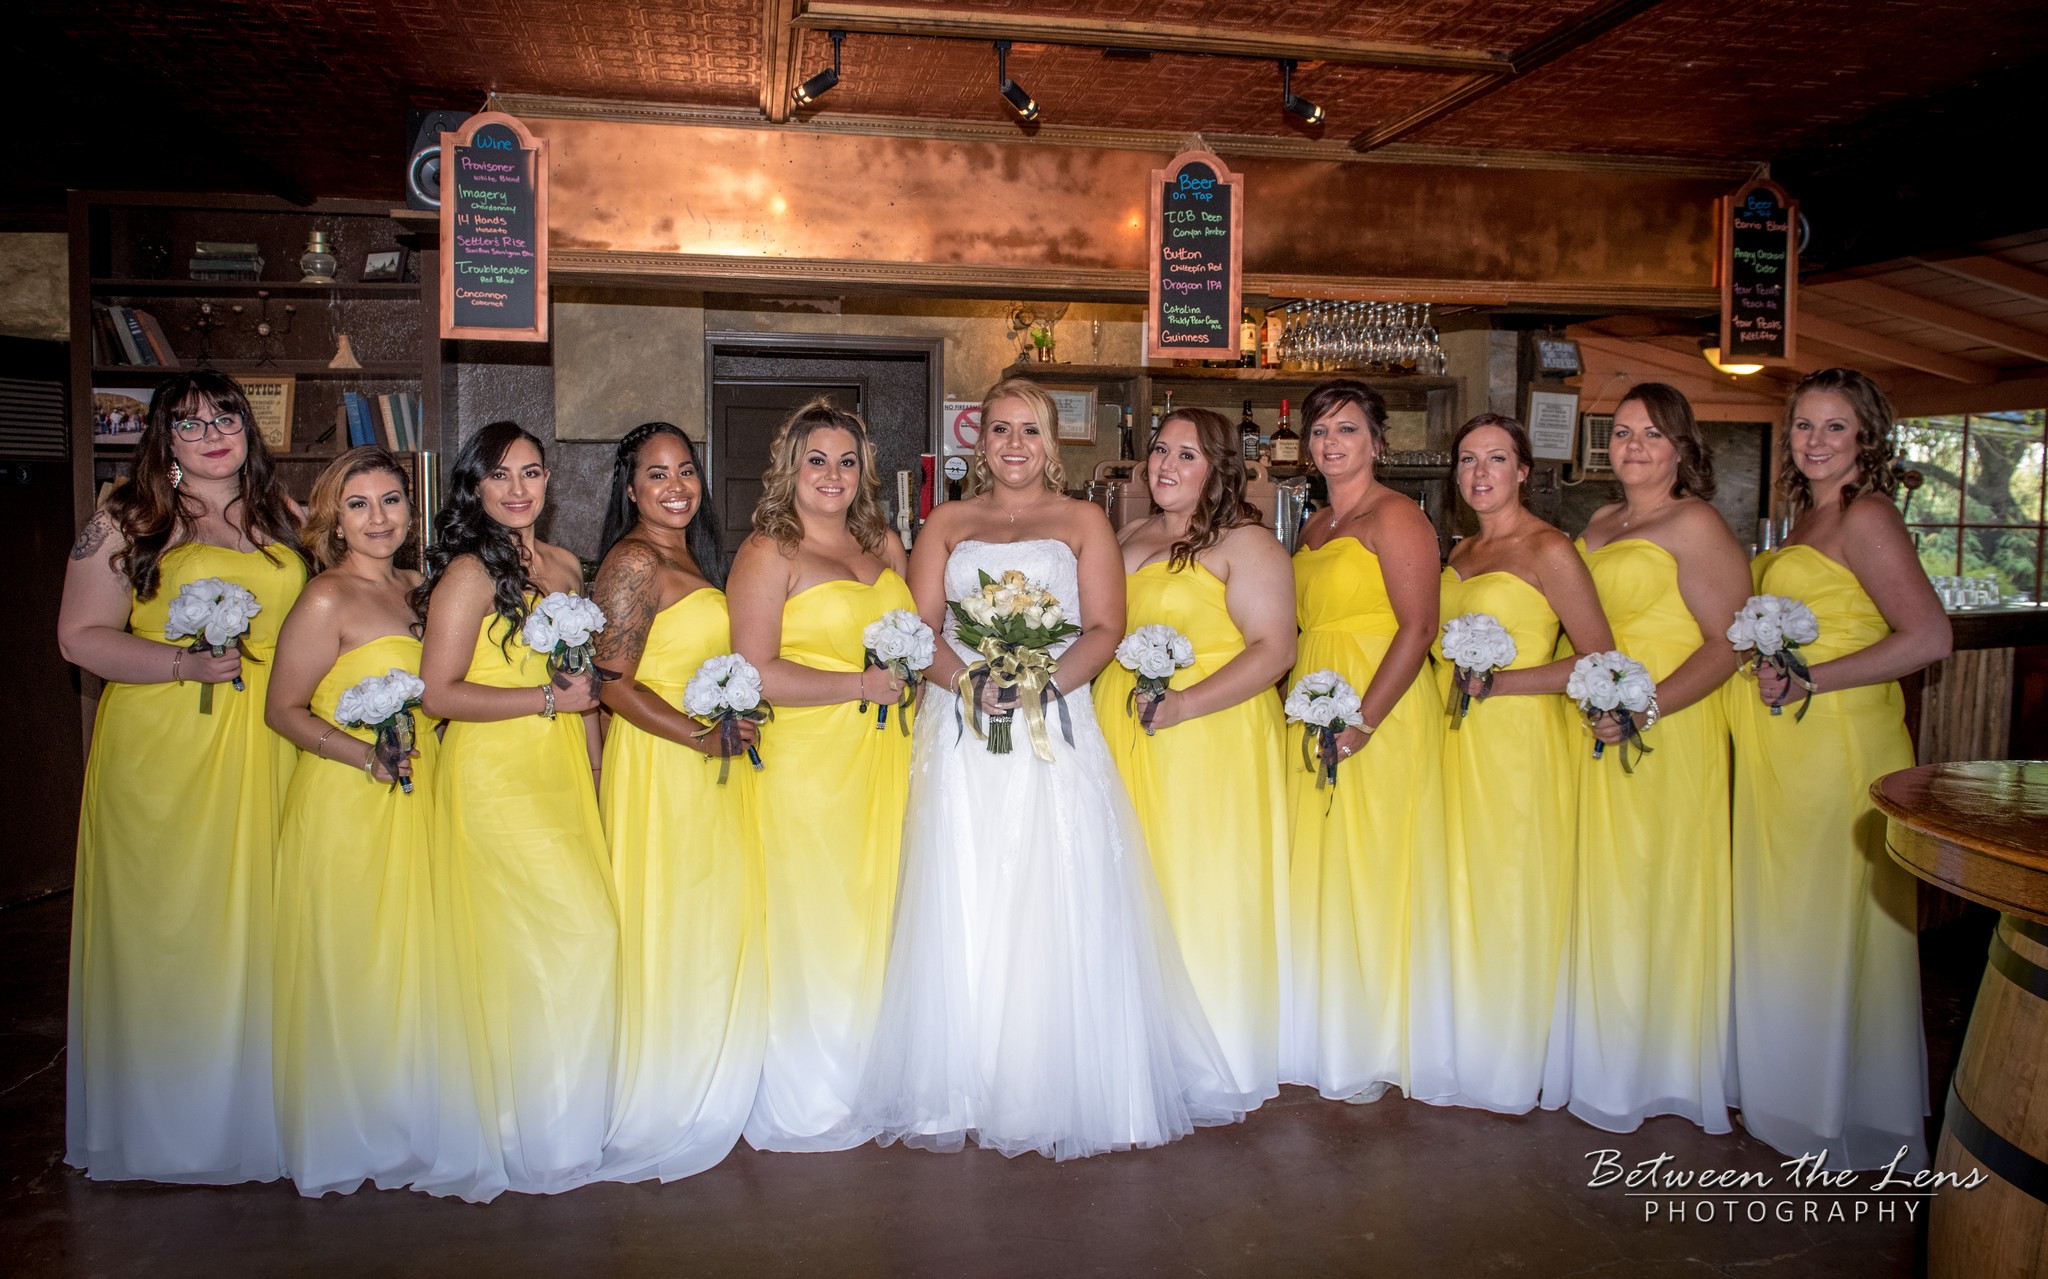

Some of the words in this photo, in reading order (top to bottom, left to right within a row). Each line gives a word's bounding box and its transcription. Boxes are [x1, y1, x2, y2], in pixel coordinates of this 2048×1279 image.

[477, 133, 512, 151] Wine
[1178, 174, 1216, 191] Beer
[458, 184, 507, 205] Imagery
[1191, 191, 1213, 202] Tap
[471, 202, 516, 215] Chardonnay
[1164, 209, 1196, 223] TCB
[1201, 211, 1222, 223] Deep
[457, 214, 469, 226] 14
[474, 214, 507, 225] Hands
[502, 236, 526, 248] Rise
[1163, 246, 1202, 261] Button
[1734, 247, 1756, 265] Angry
[455, 260, 530, 275] Troublemaker
[1207, 262, 1222, 272] Red
[1162, 278, 1203, 295] Dragoon
[1207, 279, 1222, 291] IPA
[1163, 302, 1201, 314] Catalina
[1161, 329, 1209, 344] Guinness
